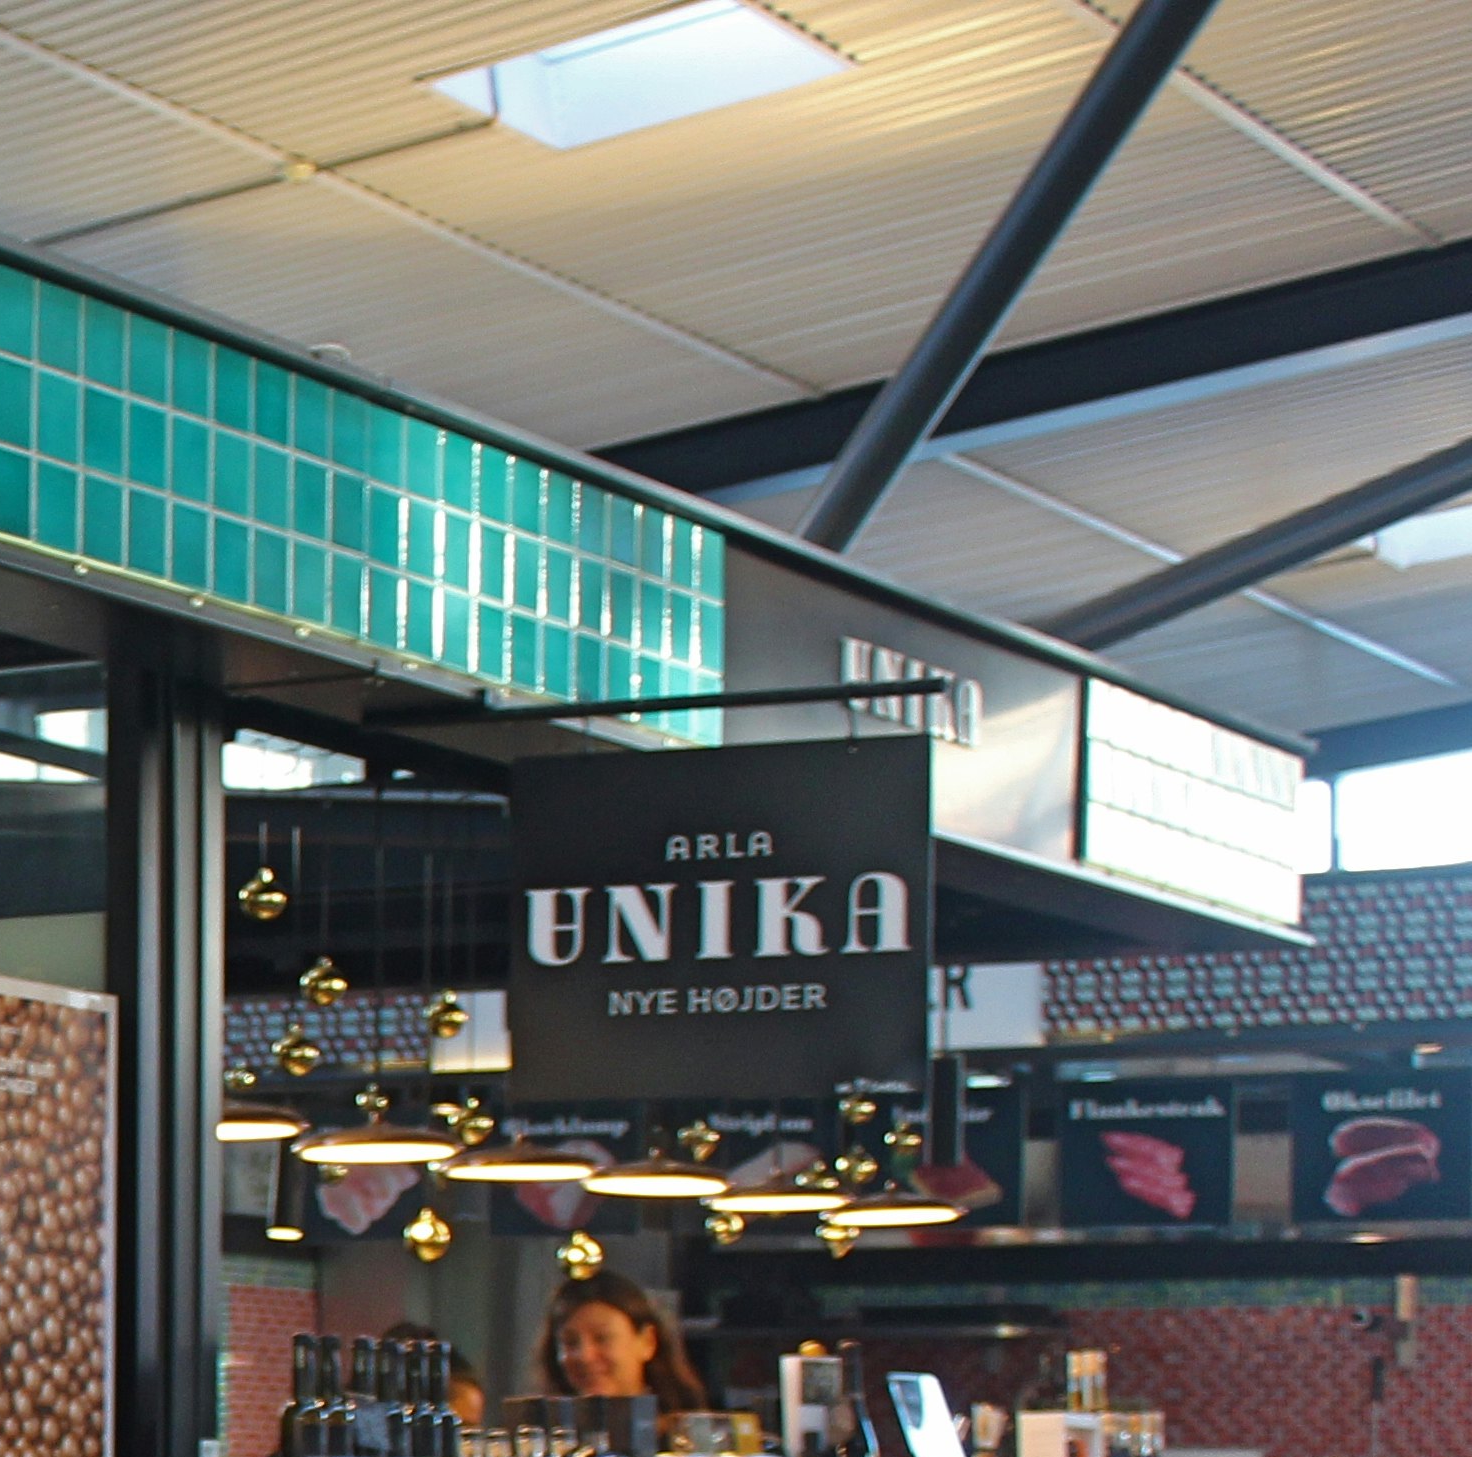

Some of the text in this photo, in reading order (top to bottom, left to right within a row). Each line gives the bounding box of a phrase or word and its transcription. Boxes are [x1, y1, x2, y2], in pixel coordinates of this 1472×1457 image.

[840, 635, 984, 748] UNIKA
[665, 829, 775, 863] ARLA
[526, 870, 913, 968] UNIKA
[608, 983, 828, 1018] NYE HØJDER
